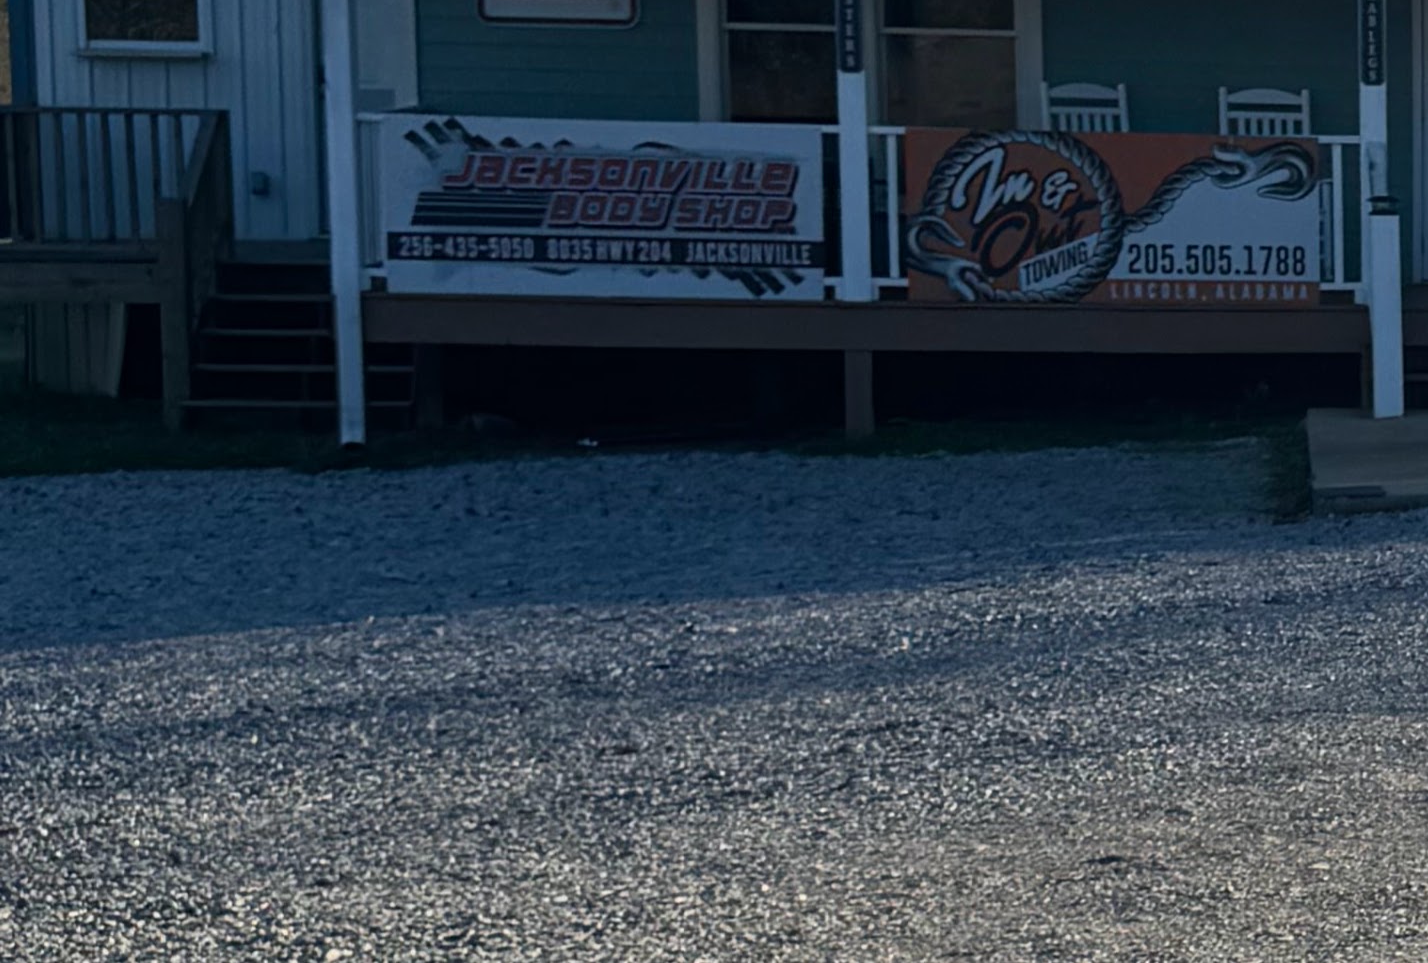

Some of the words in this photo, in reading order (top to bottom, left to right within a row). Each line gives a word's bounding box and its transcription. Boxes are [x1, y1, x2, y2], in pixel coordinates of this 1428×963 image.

[440, 150, 799, 197] JACKSONVILLE
[1040, 169, 1079, 213] &
[546, 193, 674, 230] BODY
[673, 197, 797, 234] SHOP
[399, 236, 536, 260] 256-435-5050
[594, 241, 636, 262] HWY
[685, 241, 812, 265] JACKSONVILLE
[1022, 239, 1090, 287] TOWING
[1128, 242, 1307, 276] 205.505.1788
[1109, 283, 1208, 301] LINCOLN,
[1218, 283, 1310, 300] ALABAMA
